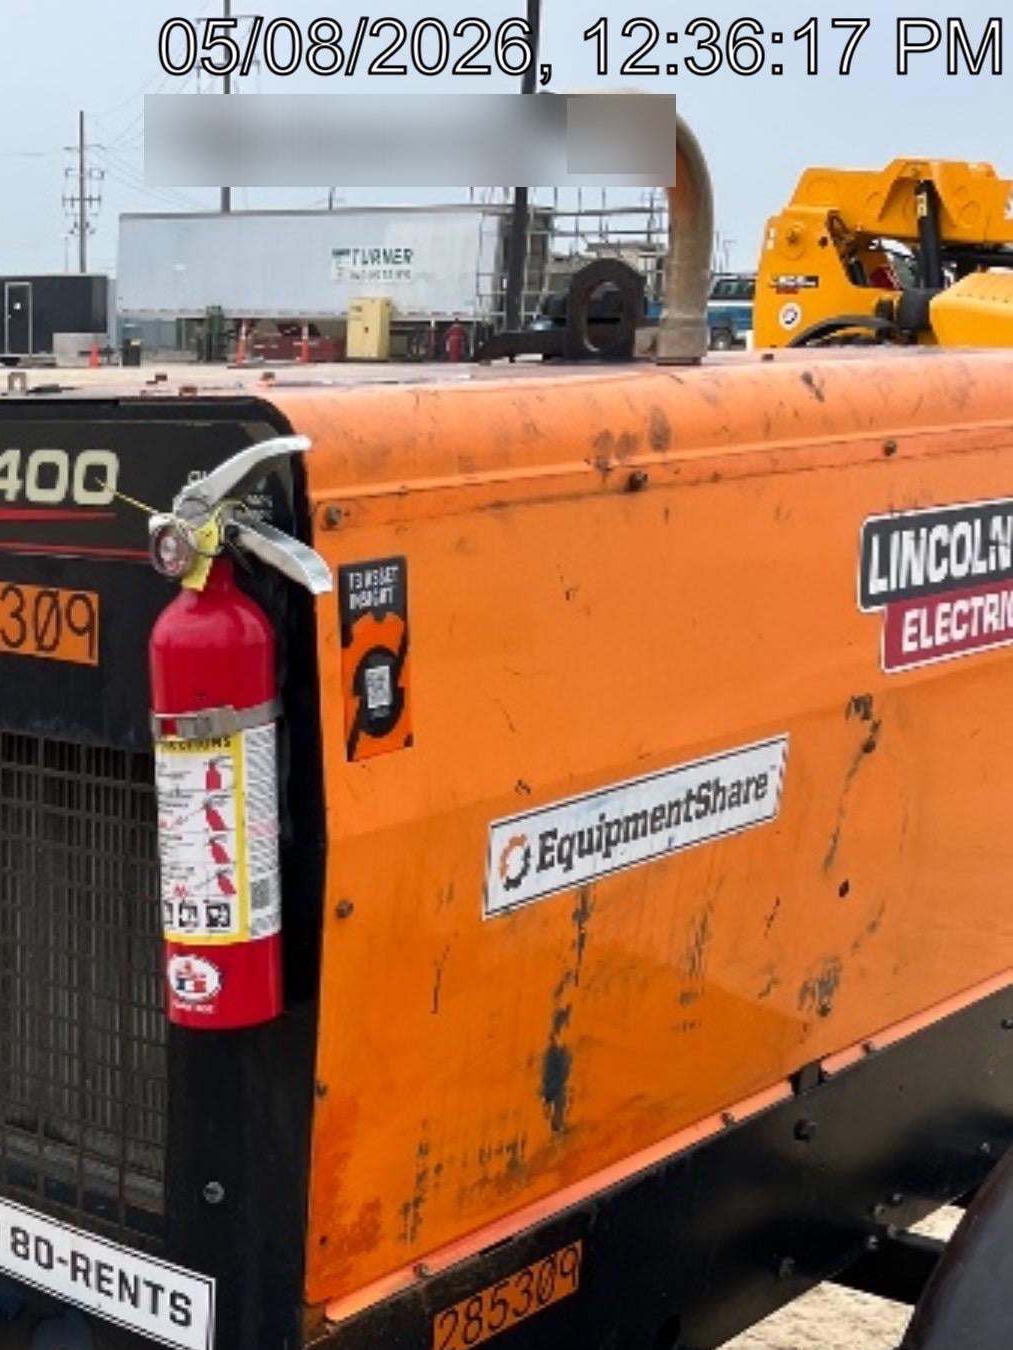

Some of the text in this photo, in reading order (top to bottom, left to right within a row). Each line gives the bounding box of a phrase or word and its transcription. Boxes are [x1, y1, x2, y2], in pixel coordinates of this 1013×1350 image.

[868, 515, 1013, 595] LINCOLN
[536, 770, 770, 874] EquipmentShare
[9, 1226, 193, 1328] 80-RENTS
